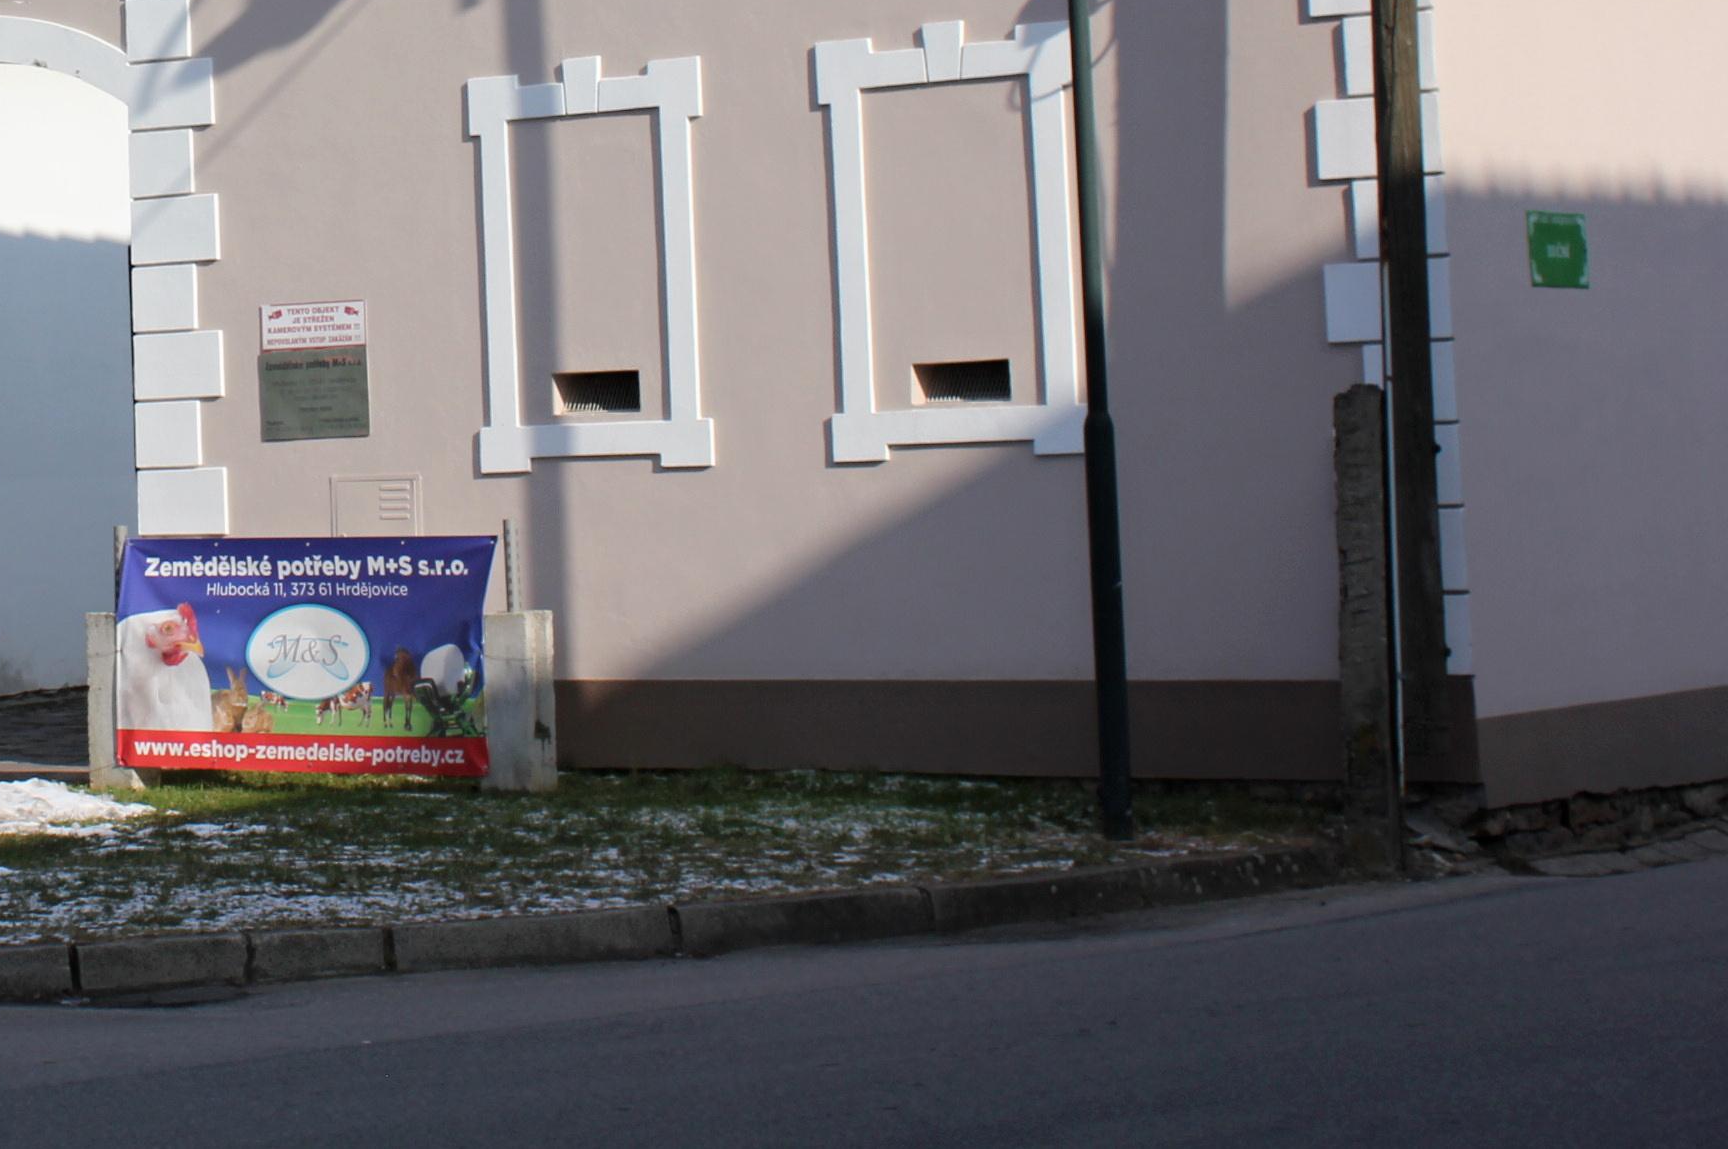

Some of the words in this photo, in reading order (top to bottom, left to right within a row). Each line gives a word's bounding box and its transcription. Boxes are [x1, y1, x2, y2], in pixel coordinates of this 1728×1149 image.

[286, 307, 310, 316] TENTO
[312, 305, 339, 314] OBJEKT
[144, 555, 272, 577] Zemědělské
[277, 555, 361, 580] potřeby
[367, 555, 413, 577] M+S
[418, 559, 469, 576] s.r.o.
[206, 582, 270, 596] Hlubocká
[273, 582, 287, 598] 11,
[290, 582, 316, 597] 373
[318, 582, 332, 597] 61
[336, 581, 408, 599] Hrdějovice
[134, 739, 465, 767] www.eshop-zemedelske-potreby.cz
